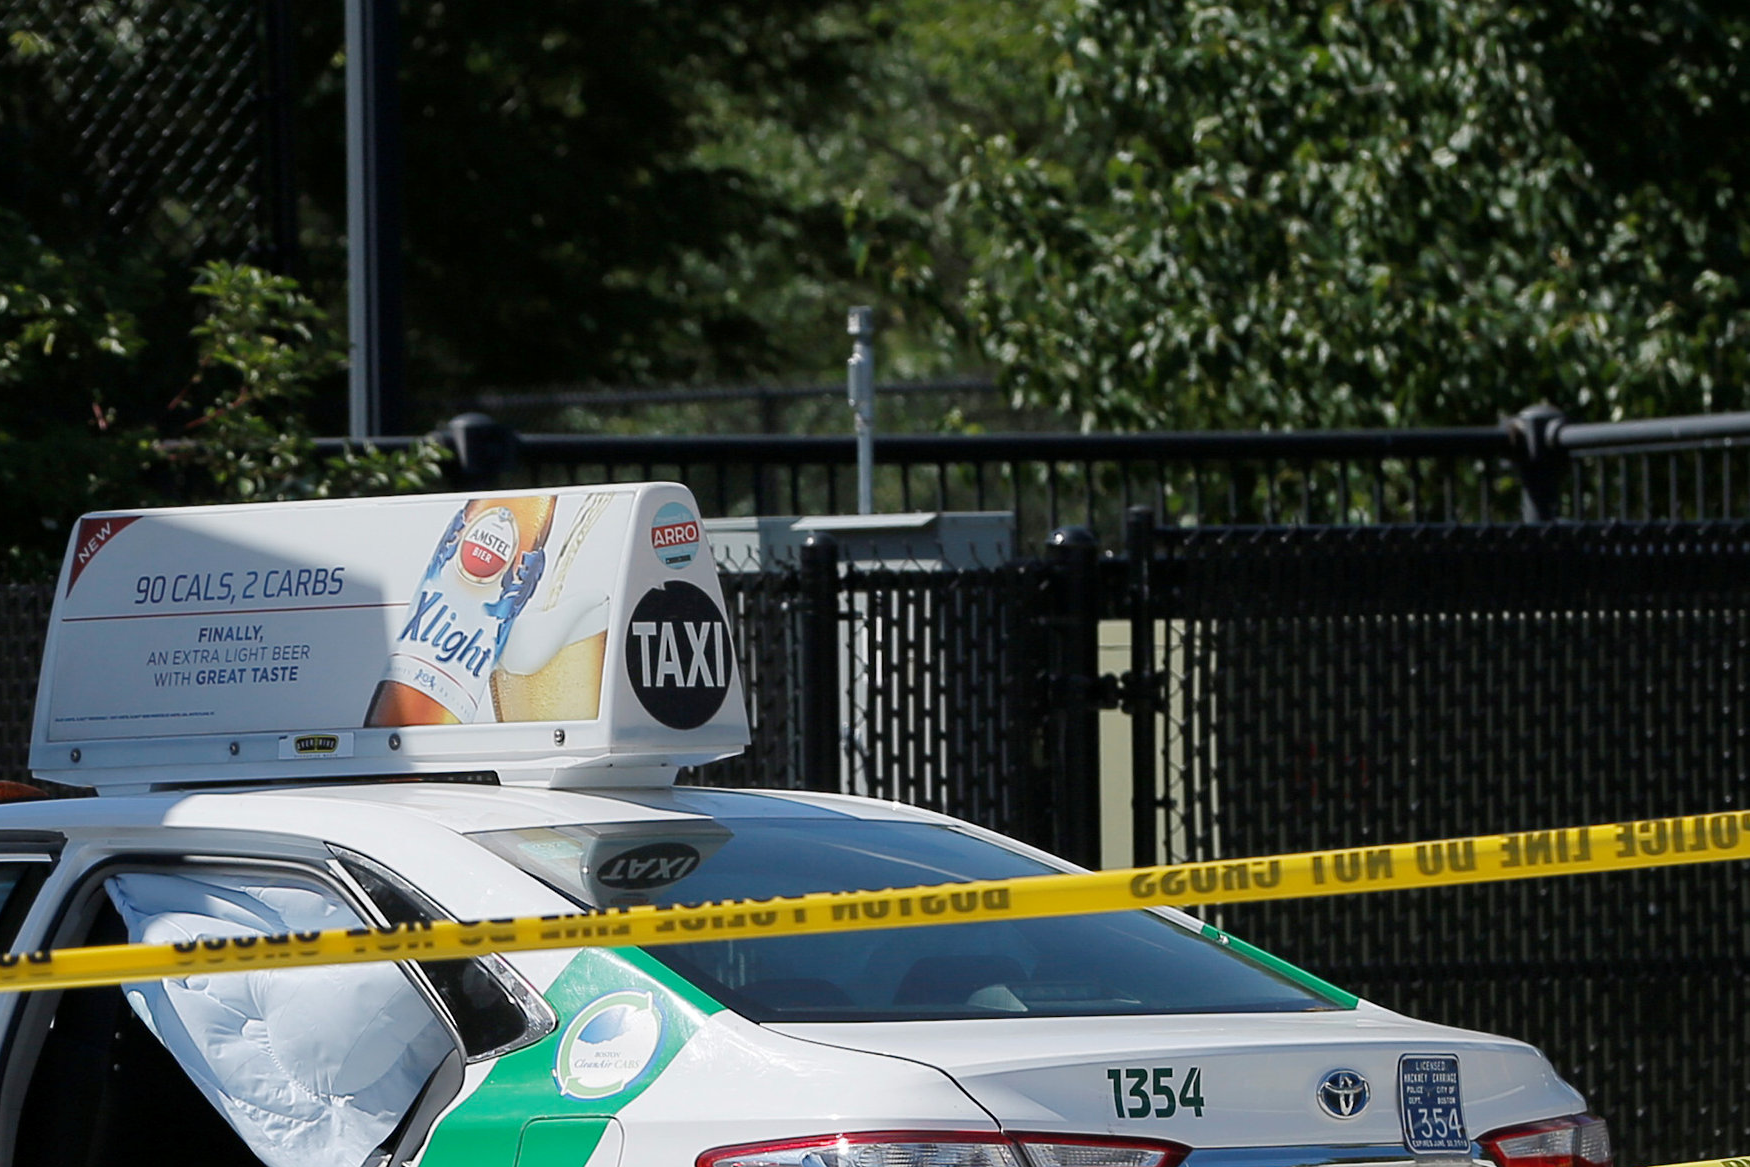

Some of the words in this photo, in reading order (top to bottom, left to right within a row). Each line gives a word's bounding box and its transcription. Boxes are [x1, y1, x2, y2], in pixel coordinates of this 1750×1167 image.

[78, 522, 111, 563] NEW
[470, 528, 511, 557] AMSTEL
[654, 524, 697, 546] ARRO
[471, 547, 493, 563] BIER
[134, 575, 167, 605] 90
[171, 572, 235, 605] CALS,
[242, 571, 259, 601] 2
[263, 567, 345, 598] CARBS
[198, 625, 264, 643] FINALLY,
[397, 591, 493, 677] Xlight
[147, 651, 168, 666] AN
[172, 650, 220, 666] EXTRA
[225, 647, 268, 663] LIGHT
[272, 645, 310, 661] BEER
[632, 621, 726, 688] TAXI
[154, 672, 191, 687] WITH
[195, 669, 246, 685] GREAT
[251, 666, 298, 683] TASTE
[1415, 1061, 1446, 1071] LICENSED
[1107, 1066, 1205, 1119] 1354
[1407, 1108, 1462, 1139] 1354
